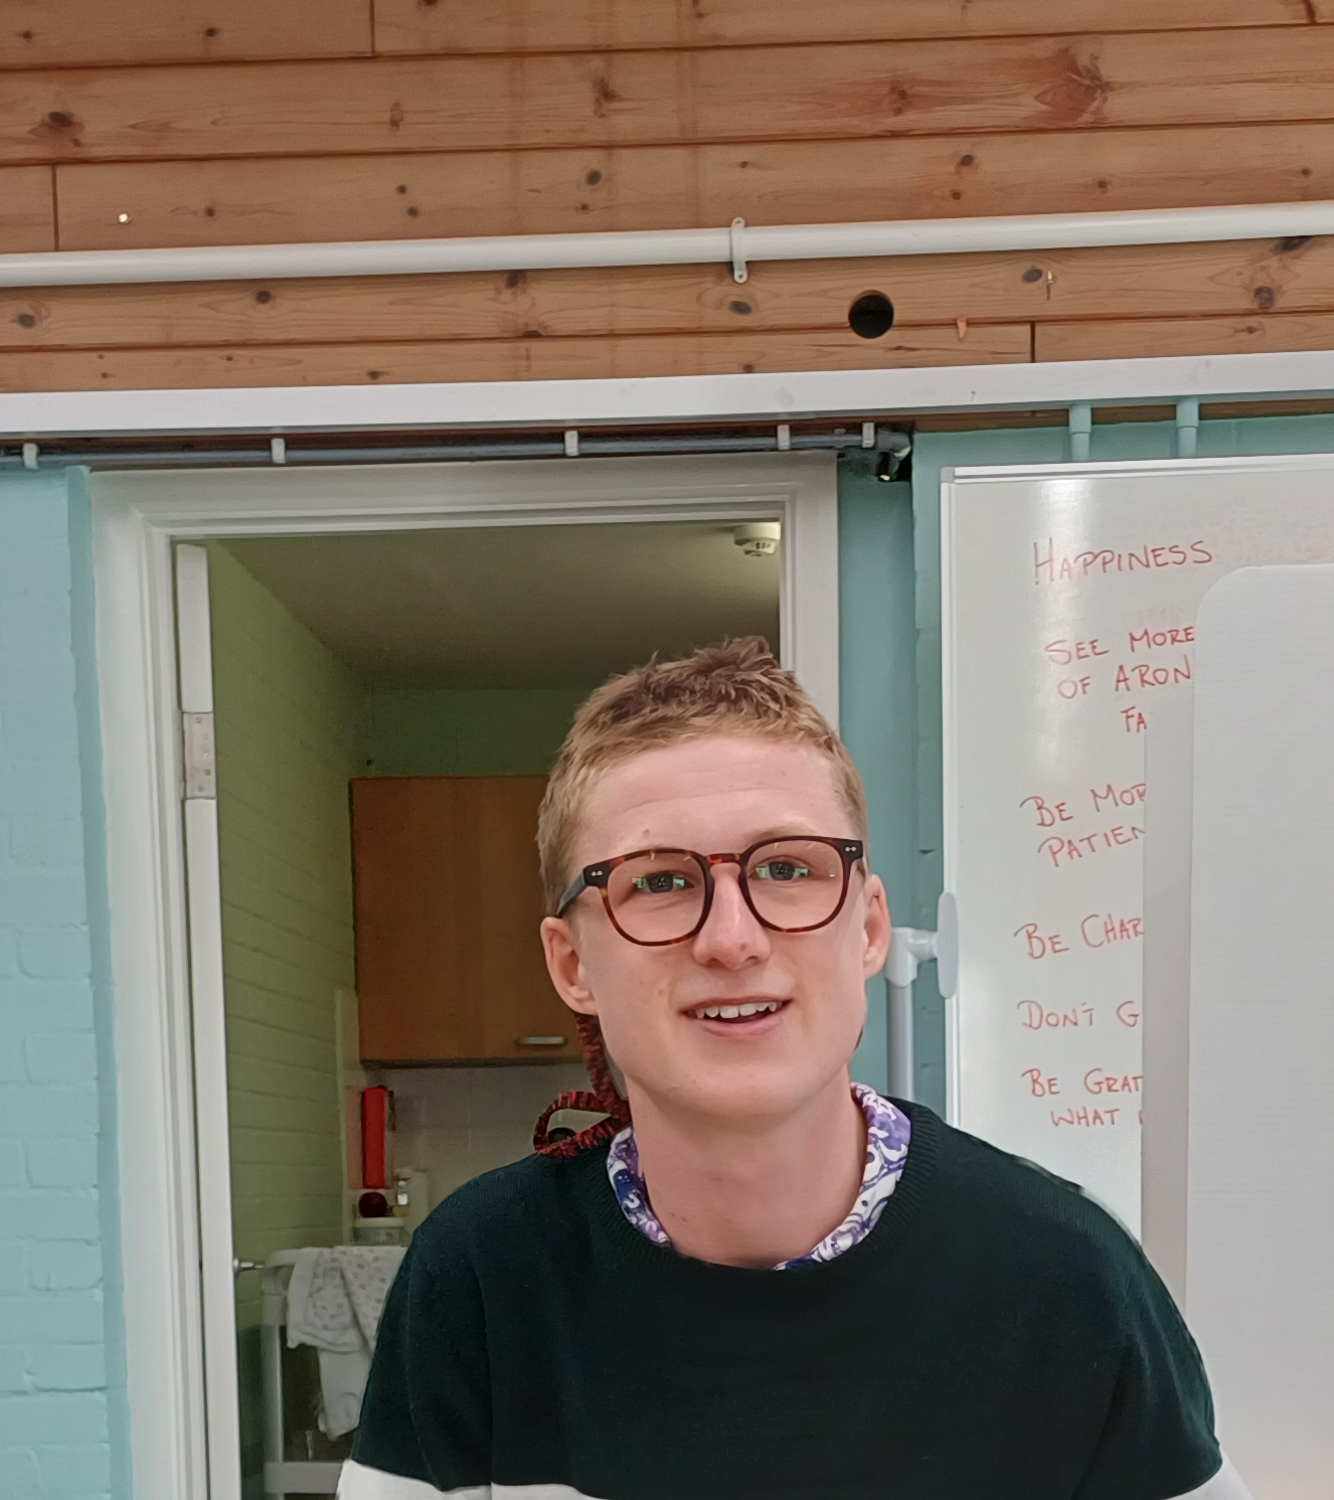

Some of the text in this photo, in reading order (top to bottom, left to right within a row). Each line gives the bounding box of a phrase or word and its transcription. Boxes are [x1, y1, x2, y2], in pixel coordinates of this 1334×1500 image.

[1033, 536, 1213, 585] HAPPINESS
[1043, 626, 1195, 666] SEE MORE
[1057, 676, 1091, 699] OF
[1019, 796, 1074, 827] BE
[1013, 923, 1069, 959] BE
[1021, 1067, 1143, 1097] BE GRAT
[1051, 1106, 1120, 1127] WHAT
